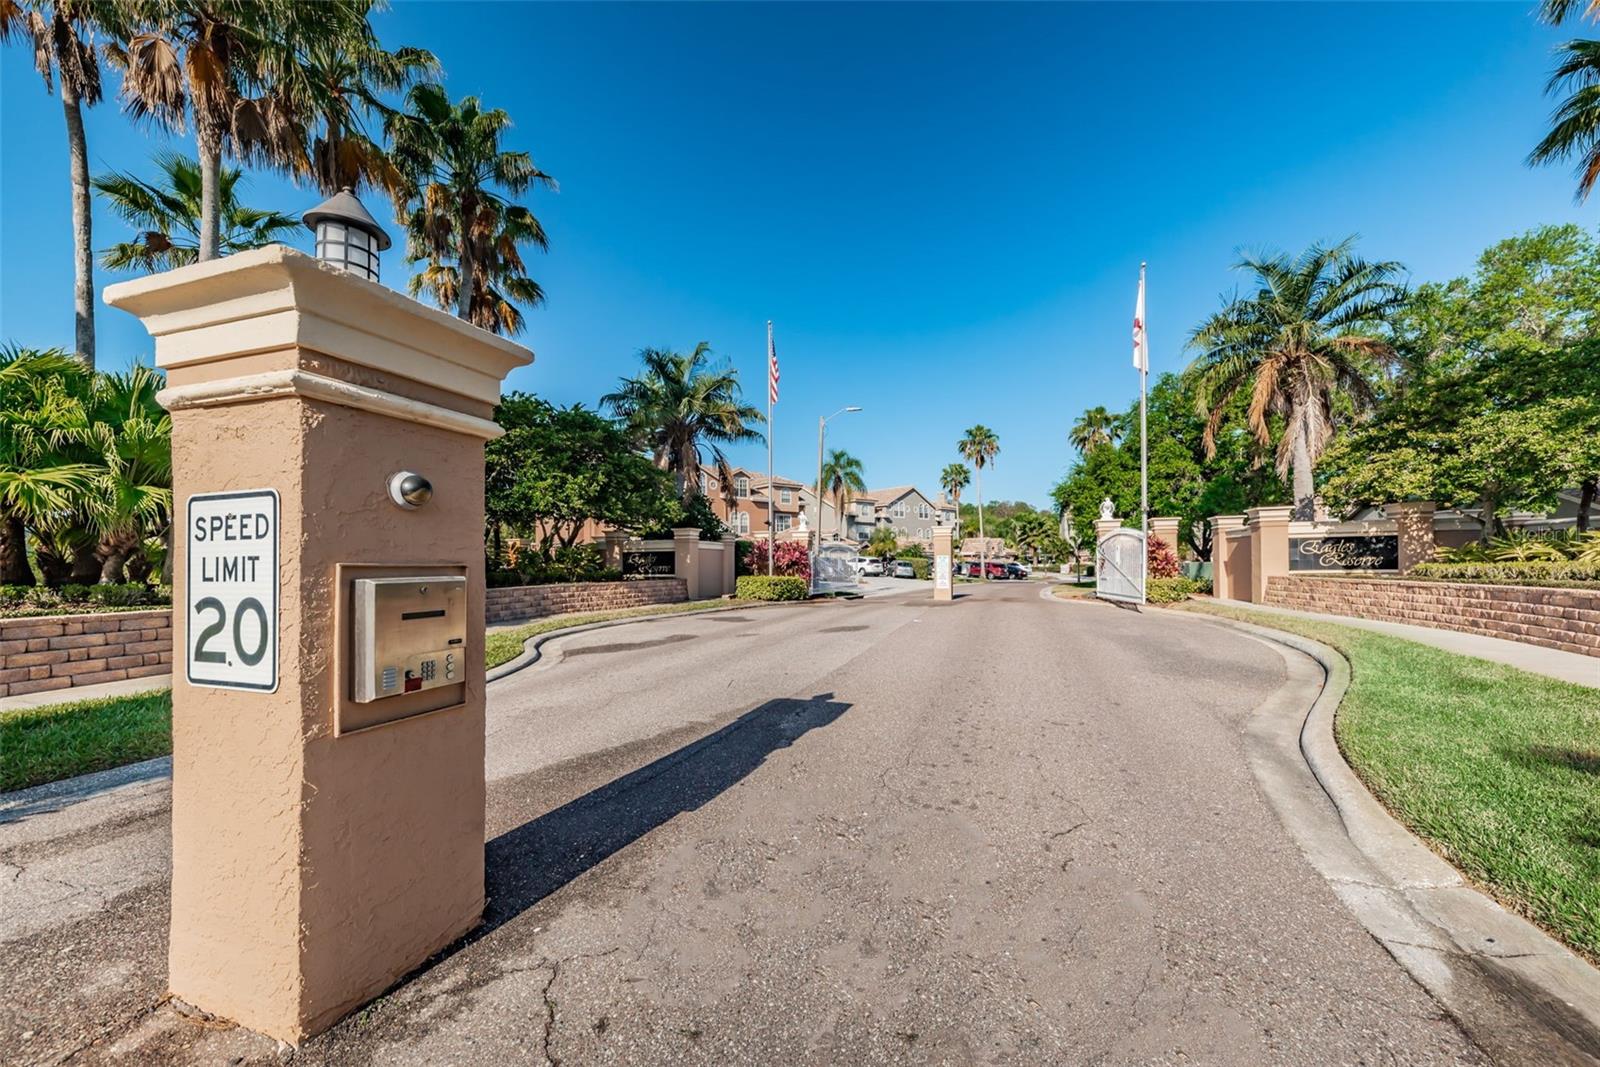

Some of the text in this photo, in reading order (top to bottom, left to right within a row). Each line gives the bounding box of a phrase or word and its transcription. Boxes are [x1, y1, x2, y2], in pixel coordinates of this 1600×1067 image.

[195, 513, 269, 541] SPEED
[1300, 539, 1357, 556] Eagles
[1320, 553, 1384, 567] Reserve
[202, 556, 260, 582] LIMIT
[194, 597, 269, 666] 20
